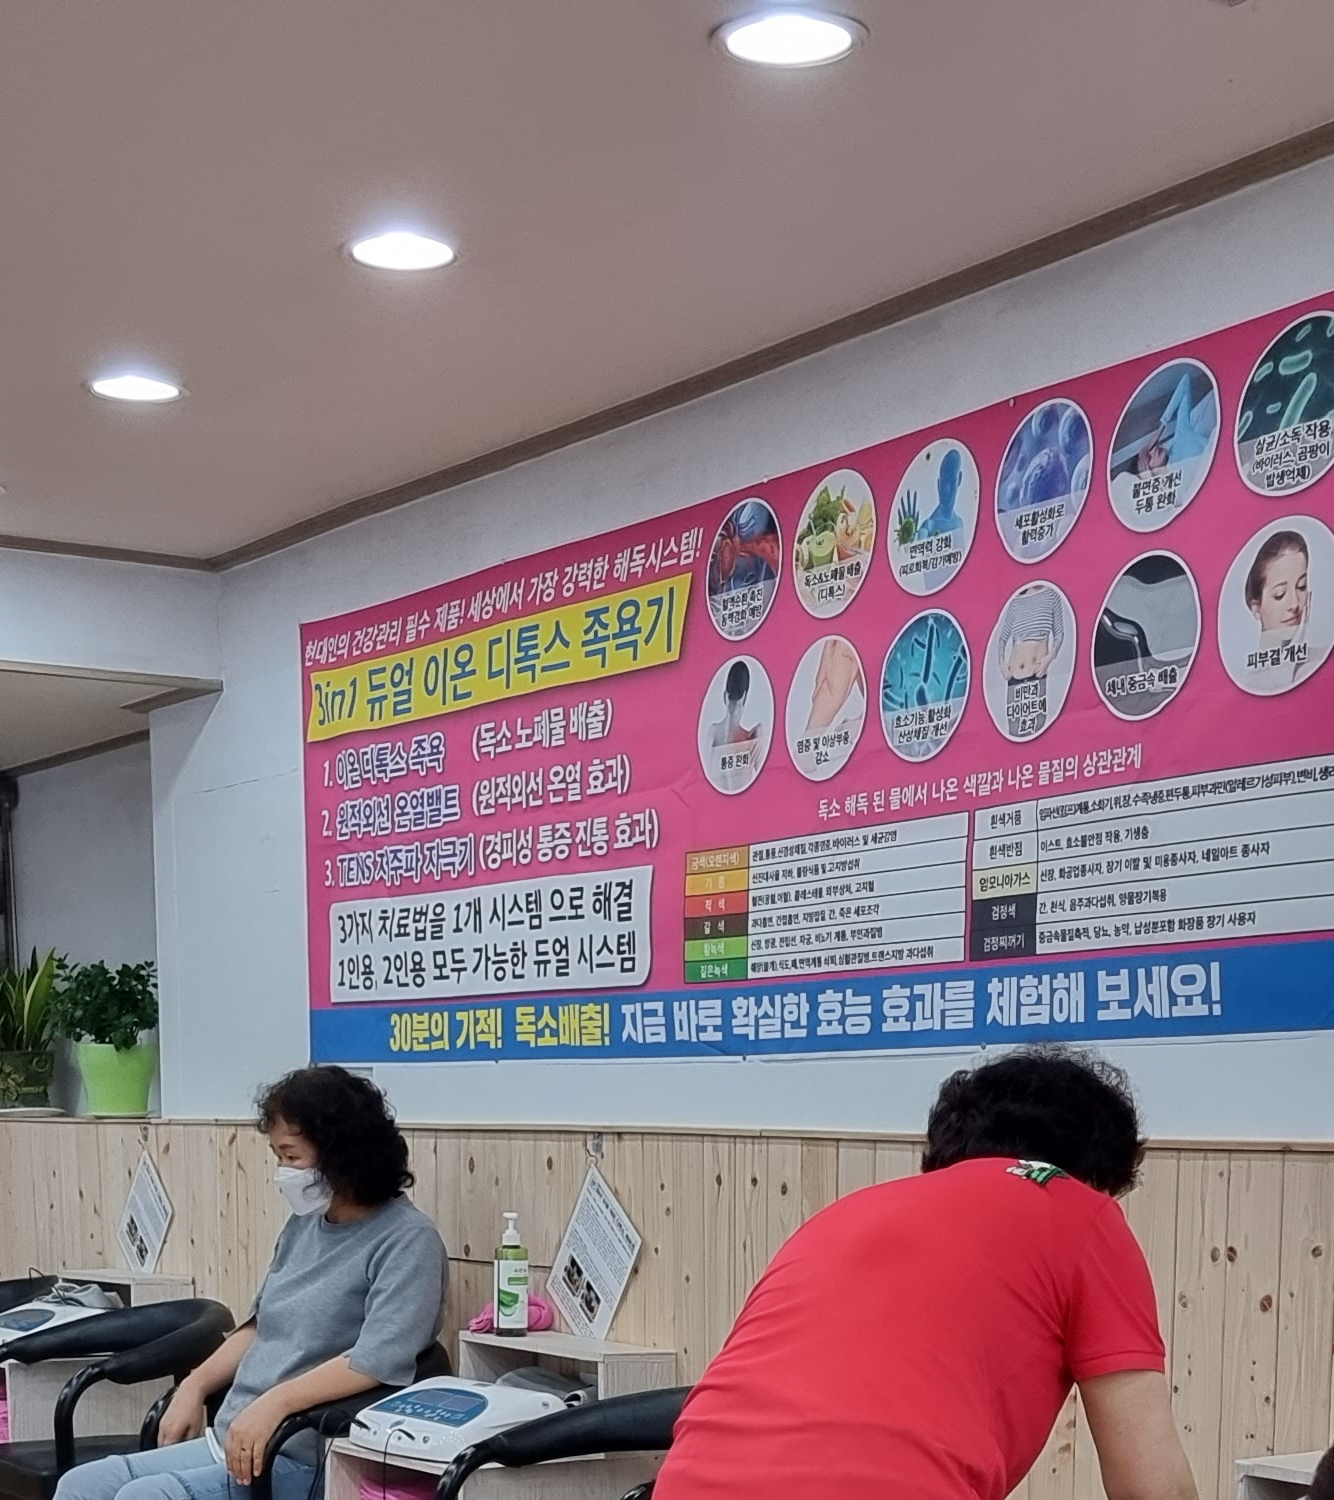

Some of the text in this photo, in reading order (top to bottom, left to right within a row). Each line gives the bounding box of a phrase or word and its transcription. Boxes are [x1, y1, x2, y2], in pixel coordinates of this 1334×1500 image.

[1305, 419, 1332, 440] 작용
[1297, 440, 1330, 461] 곰팡이
[1132, 470, 1183, 499] 불면증 개선
[1266, 465, 1311, 488] 발생억제)
[1134, 491, 1177, 515] 두통 완화
[1014, 503, 1065, 530] 세포활성화로
[1021, 524, 1055, 546] 활력증가
[909, 533, 952, 560] 면역력 강화
[305, 527, 705, 666] 현대인의 건강관리 필수 제품! 세상에서 가장 강력한 해독시스템!
[818, 583, 846, 602] (디톡스)
[314, 586, 677, 727] 3in1 듀얼 이온 디톡스 족욕기
[1247, 643, 1308, 669] 피부결 개선
[1015, 682, 1040, 700] 비만과
[1106, 666, 1179, 697] 체내 중금속 배출
[894, 703, 953, 730] 효소기능 활성화
[1006, 698, 1047, 718] 다이어트에
[931, 721, 948, 738] 개선
[1019, 717, 1036, 733] 효과
[323, 698, 614, 790] 1. 이온 디톡스 족욕 (독소 노폐물 배출)
[796, 737, 812, 754] 염증
[720, 752, 750, 771] 통증 완화
[814, 750, 830, 766] 감소
[817, 742, 1143, 823] 독소 해독 된 물에서 나온 색깔과 나온 물질의 상관관계
[322, 810, 334, 837] 2.
[336, 793, 392, 840] 원적외선
[472, 767, 544, 816] (원적외선
[546, 760, 583, 800] 온열
[586, 753, 632, 796] 효과)
[990, 810, 1022, 830] 흰색거품
[324, 861, 336, 887] 3.
[423, 832, 475, 881] 자극기
[478, 825, 534, 871] (경피성
[536, 821, 573, 862] 통증
[574, 815, 611, 857] 진통
[613, 808, 660, 851] 효과)
[989, 841, 1023, 861] 흰색반점
[1107, 859, 1122, 874] 장기
[1124, 857, 1140, 871] 이발
[1143, 855, 1152, 870] 및
[1202, 845, 1238, 863] 네일아트
[1240, 841, 1271, 857] 종사자
[979, 871, 1031, 893] 암모니아가스
[338, 878, 636, 945] 3가지 치료법을 1개 시스템 으로 해결
[853, 903, 880, 918] 세포조각
[991, 903, 1017, 921] 검정색
[1178, 915, 1204, 931] 화장품
[1206, 914, 1225, 929] 장기
[1227, 911, 1257, 927] 사용자
[337, 930, 638, 991] 1인용, 2인용 모두 가능한 듀얼 시스템
[906, 945, 934, 960] 과다섭취
[388, 960, 1222, 1053] 30분의 기적! 독소배출! 지금 바로 확실한 효능 효과를 체험해 보세요!
